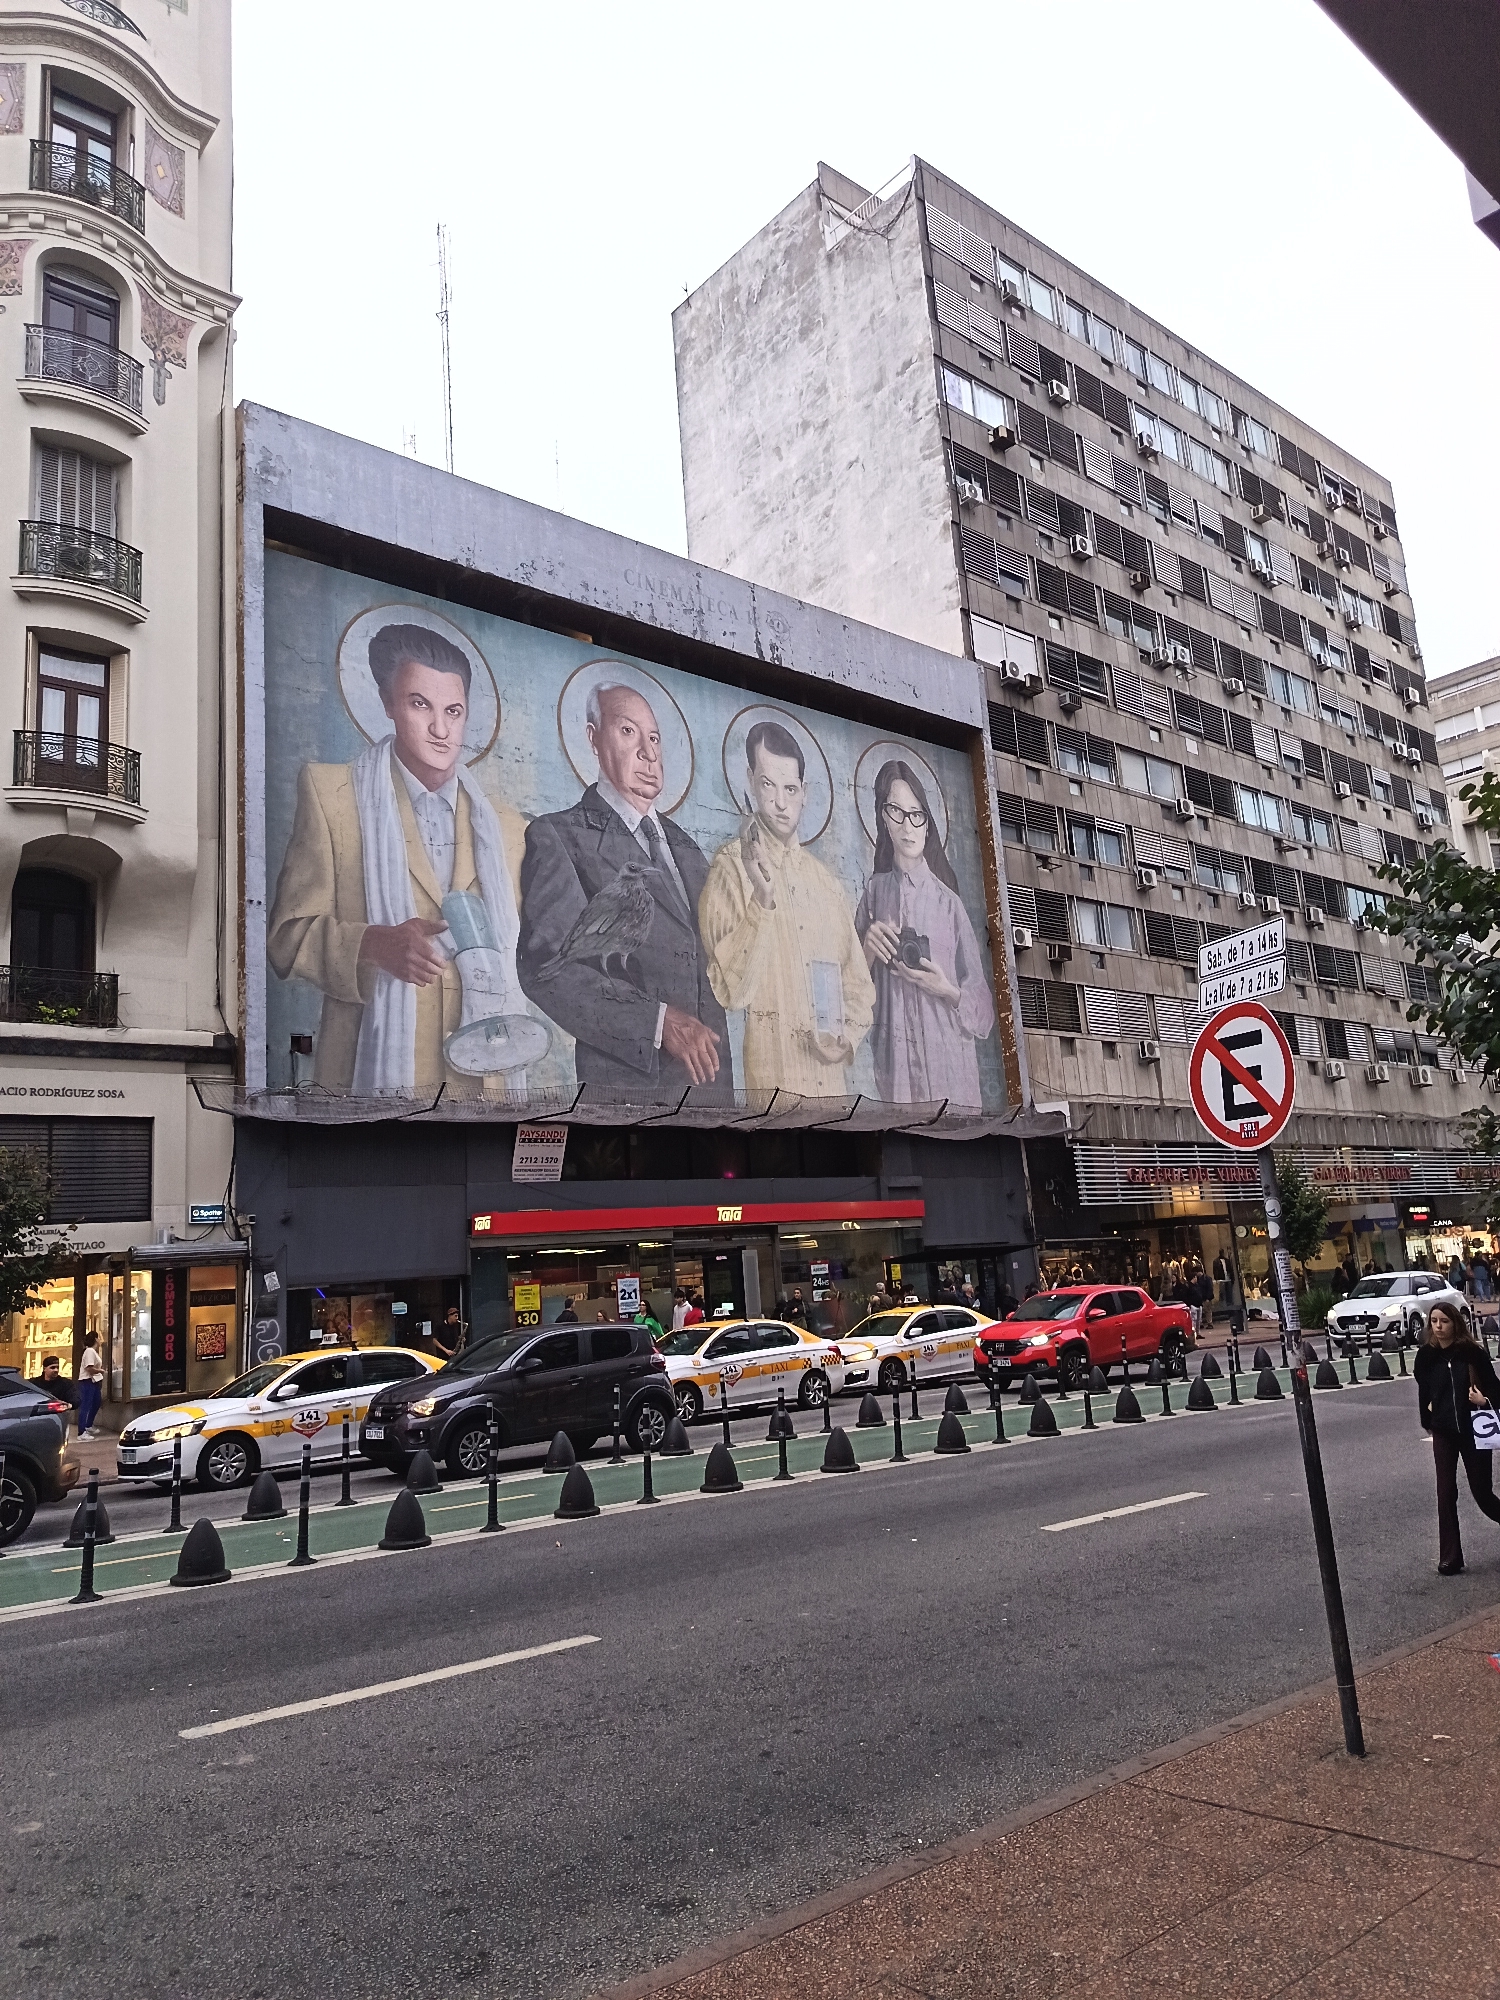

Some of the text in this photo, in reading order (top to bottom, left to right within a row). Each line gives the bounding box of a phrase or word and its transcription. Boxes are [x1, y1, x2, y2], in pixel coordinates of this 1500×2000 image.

[1227, 943, 1237, 963] de
[1240, 940, 1245, 959] 7
[1248, 941, 1254, 956] a
[1257, 932, 1267, 953] 14
[1268, 930, 1278, 950] hs
[1213, 989, 1218, 1004] a
[1226, 980, 1237, 999] de
[1240, 977, 1245, 995] 7
[1248, 978, 1253, 993] a
[1256, 971, 1267, 991] 21
[1268, 968, 1279, 988] hs
[1218, 1029, 1268, 1121] E
[0, 1087, 125, 1098] ACIO RODRÍGUEZ SOSA
[519, 1130, 566, 1138] PAYSANDU
[519, 1156, 559, 1164] 2712 1570
[1126, 1167, 1259, 1182] GALERIA DEL VIRREY
[620, 1288, 638, 1300] 2x1
[165, 1274, 175, 1361] COMPRO ORO
[518, 1312, 539, 1325] $30
[923, 1344, 934, 1353] 141
[956, 1341, 971, 1350] TAXI
[723, 1365, 738, 1375] 141
[770, 1363, 789, 1373] TAXI
[298, 1410, 321, 1422] 141
